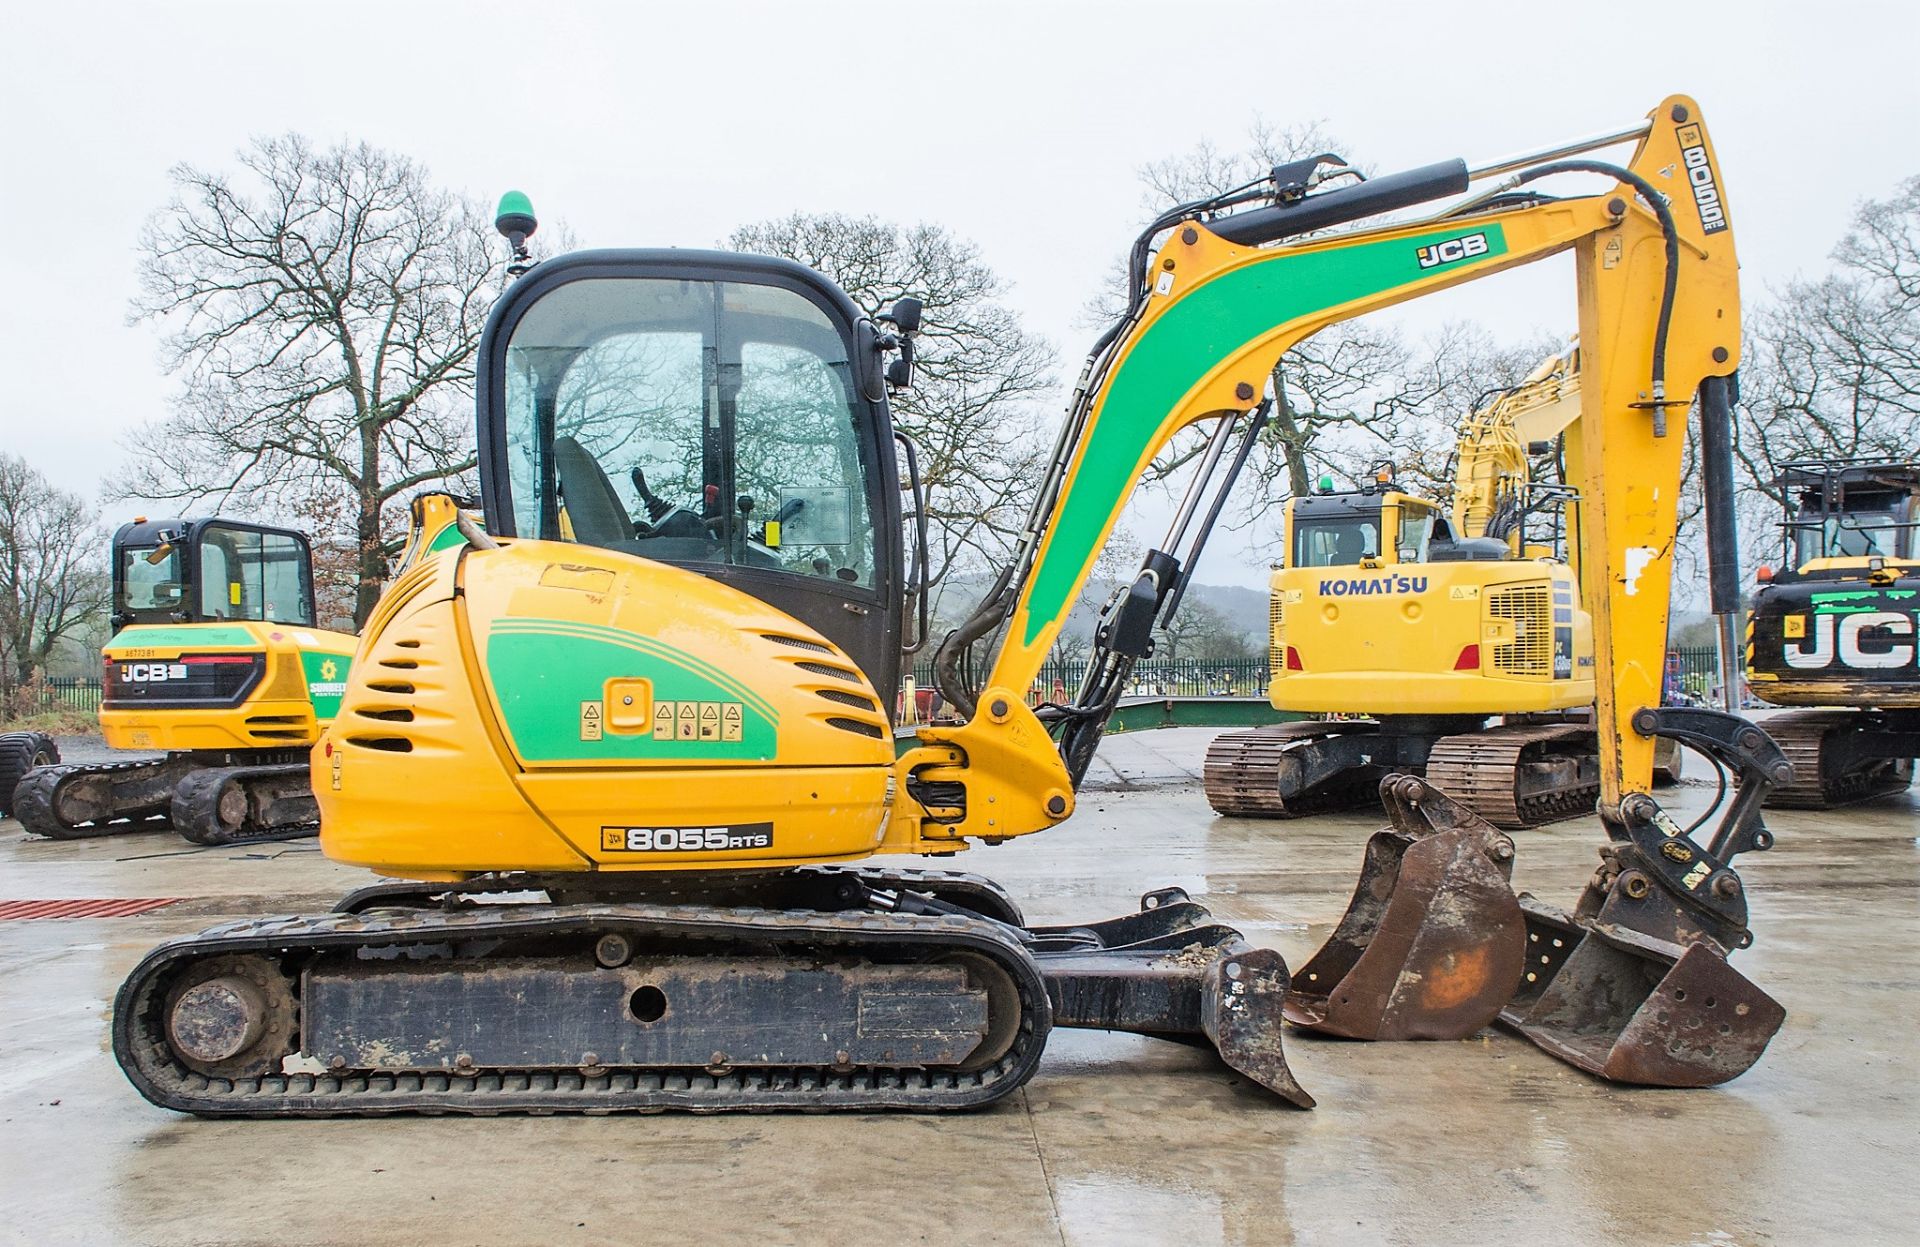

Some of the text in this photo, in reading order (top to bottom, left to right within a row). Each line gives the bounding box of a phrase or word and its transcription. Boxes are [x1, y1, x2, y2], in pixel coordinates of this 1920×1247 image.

[1418, 234, 1488, 267] JCB
[1319, 573, 1427, 596] KOMATSU
[1784, 612, 1920, 669] JC
[121, 664, 168, 682] JCB
